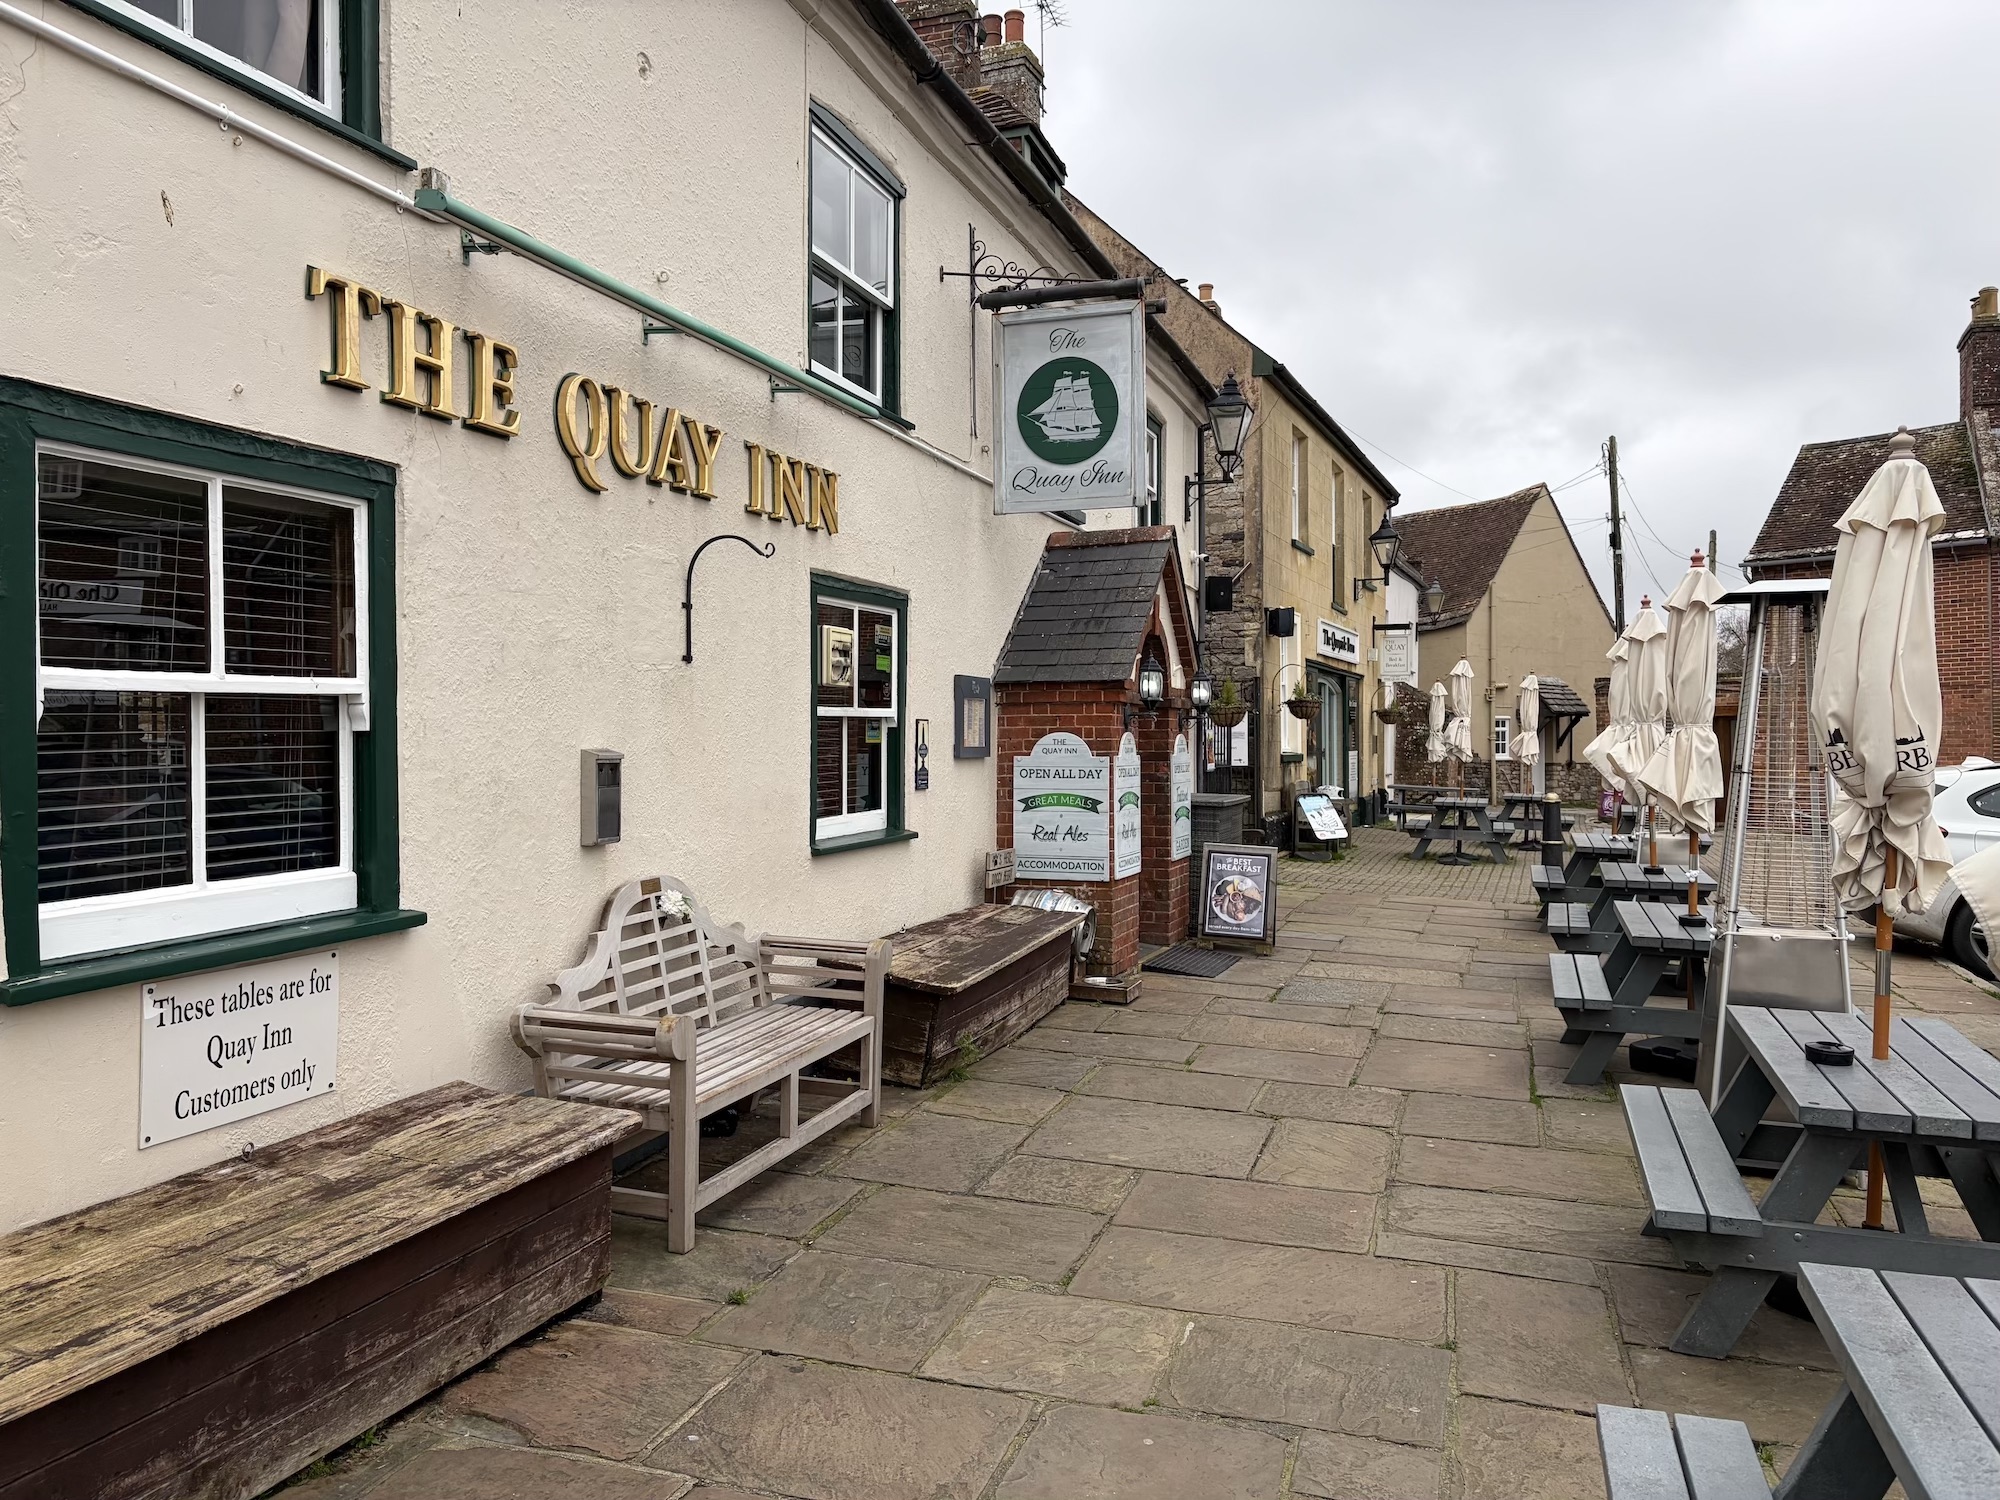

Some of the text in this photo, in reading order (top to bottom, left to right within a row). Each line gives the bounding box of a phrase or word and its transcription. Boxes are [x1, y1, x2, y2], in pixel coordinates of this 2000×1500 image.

[1049, 328, 1086, 352] The
[306, 264, 841, 536] THE QUAY INN
[1012, 459, 1126, 494] Quay Inn
[1384, 644, 1406, 652] QUAY
[1895, 747, 1932, 771] RB
[1020, 768, 1103, 779] OPEN ALL DAY
[1028, 796, 1093, 808] GREAT MEALS
[1031, 824, 1089, 842] Real Ales
[1017, 860, 1104, 871] ACCOMMODATION
[1216, 863, 1262, 873] BREAKFAST
[1233, 857, 1252, 866] BEST
[153, 968, 332, 1028] These tables are for
[207, 1023, 292, 1069] Quay Inn
[175, 1058, 316, 1119] Customers only
